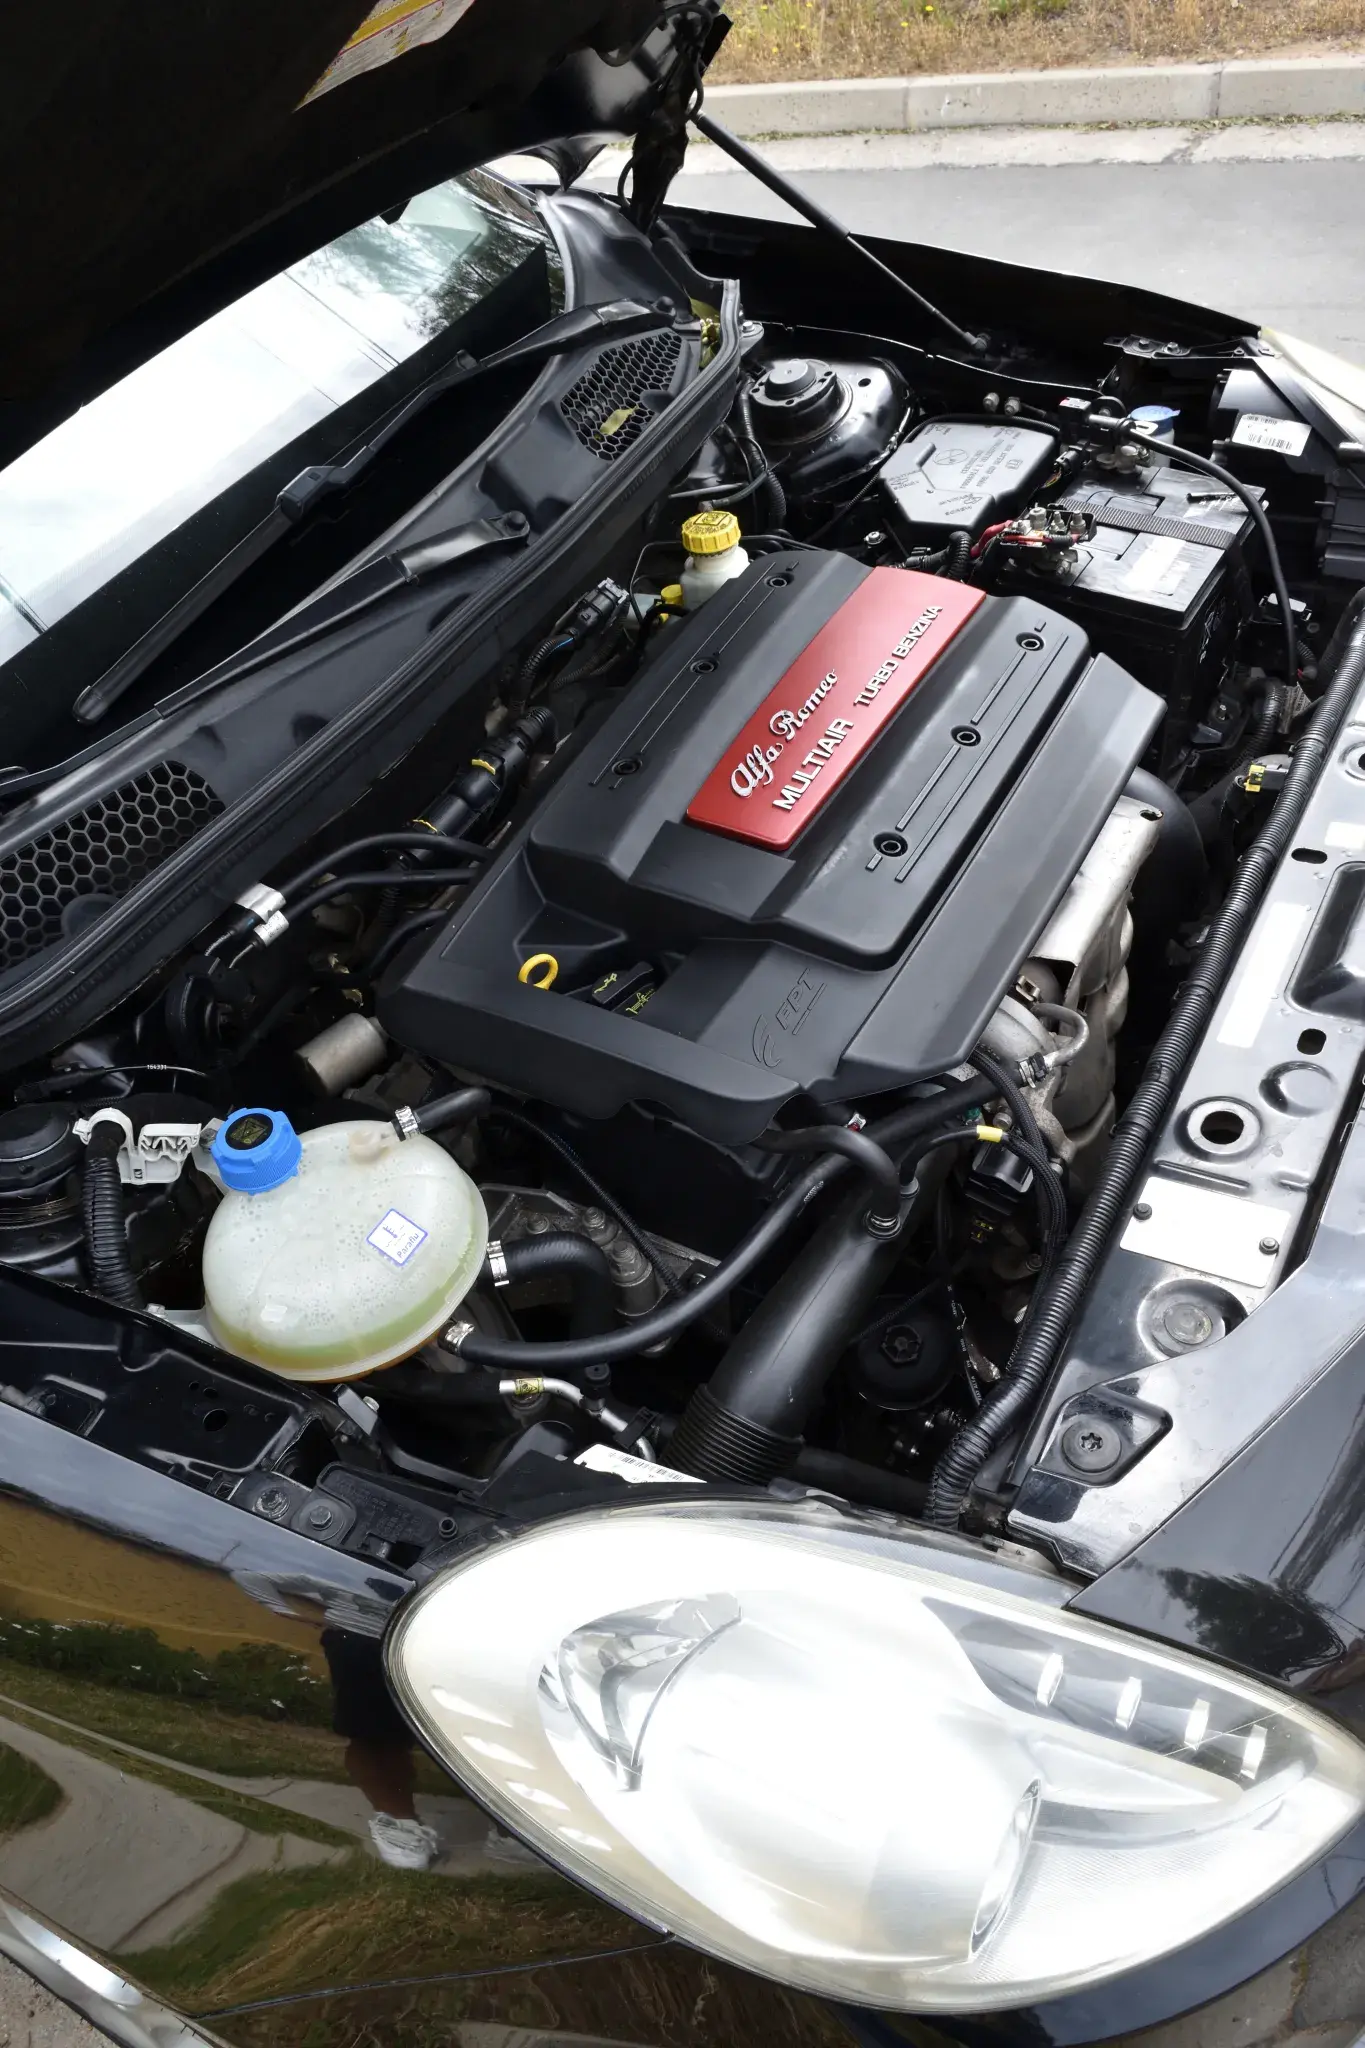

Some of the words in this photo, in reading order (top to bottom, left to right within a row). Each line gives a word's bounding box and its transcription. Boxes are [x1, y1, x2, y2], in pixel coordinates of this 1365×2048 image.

[853, 659, 900, 708] TURBO
[892, 605, 943, 659] BENZINA
[730, 742, 784, 798] Alfa
[769, 668, 839, 741] Romeo
[772, 717, 854, 811] MULTIAIR
[775, 966, 814, 1031] FPT
[396, 1233, 420, 1259] Paraflu
